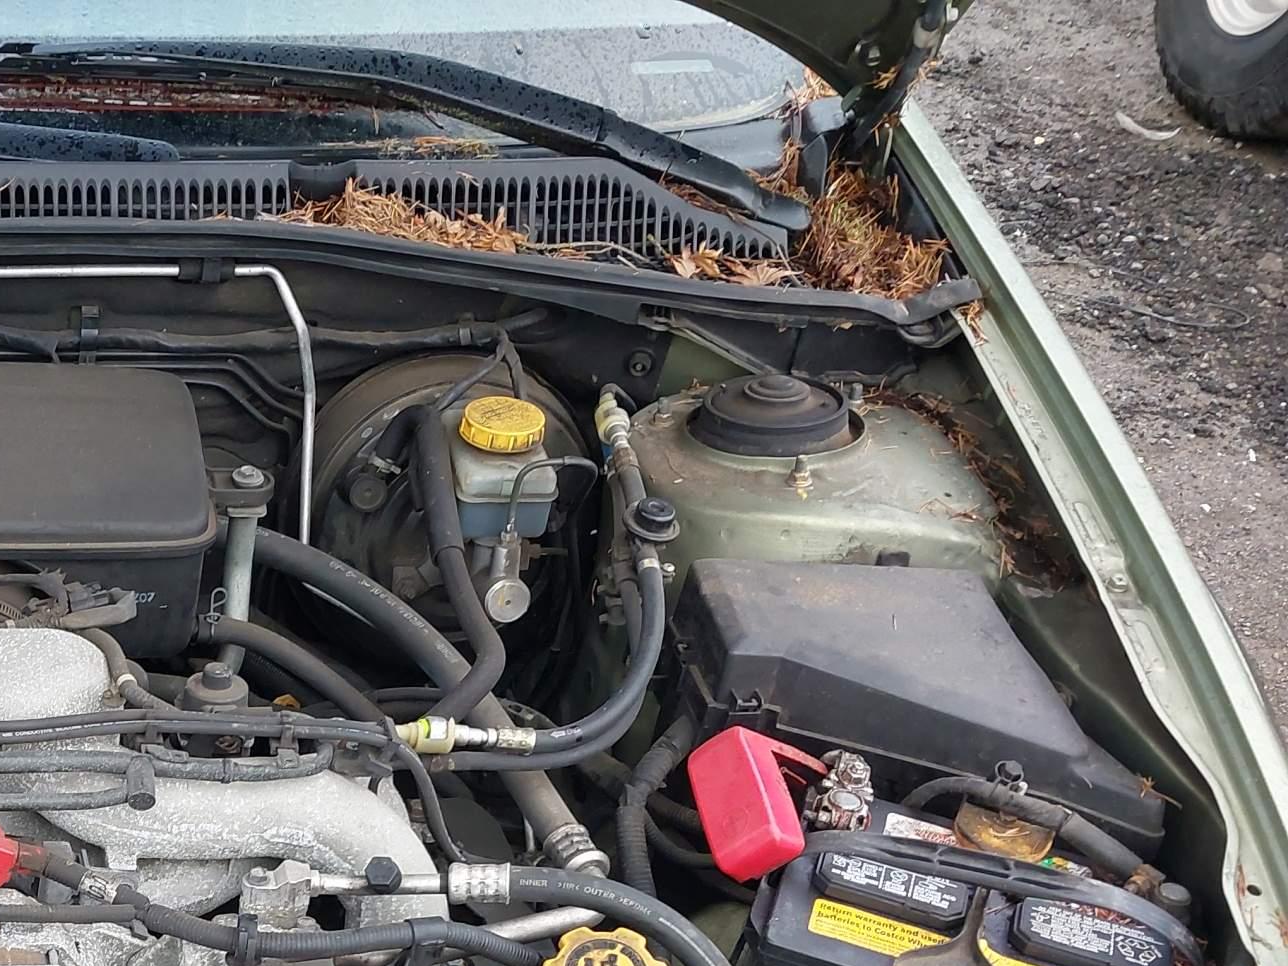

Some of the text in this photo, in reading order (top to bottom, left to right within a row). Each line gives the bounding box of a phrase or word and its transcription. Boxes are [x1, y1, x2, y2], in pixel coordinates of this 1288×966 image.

[519, 878, 548, 888] INNER
[583, 886, 616, 900] OUTER
[817, 910, 861, 928] batteries
[862, 924, 872, 932] to
[874, 925, 905, 942] Costco
[819, 903, 853, 916] Return
[855, 914, 899, 932] warranty
[900, 927, 919, 938] and
